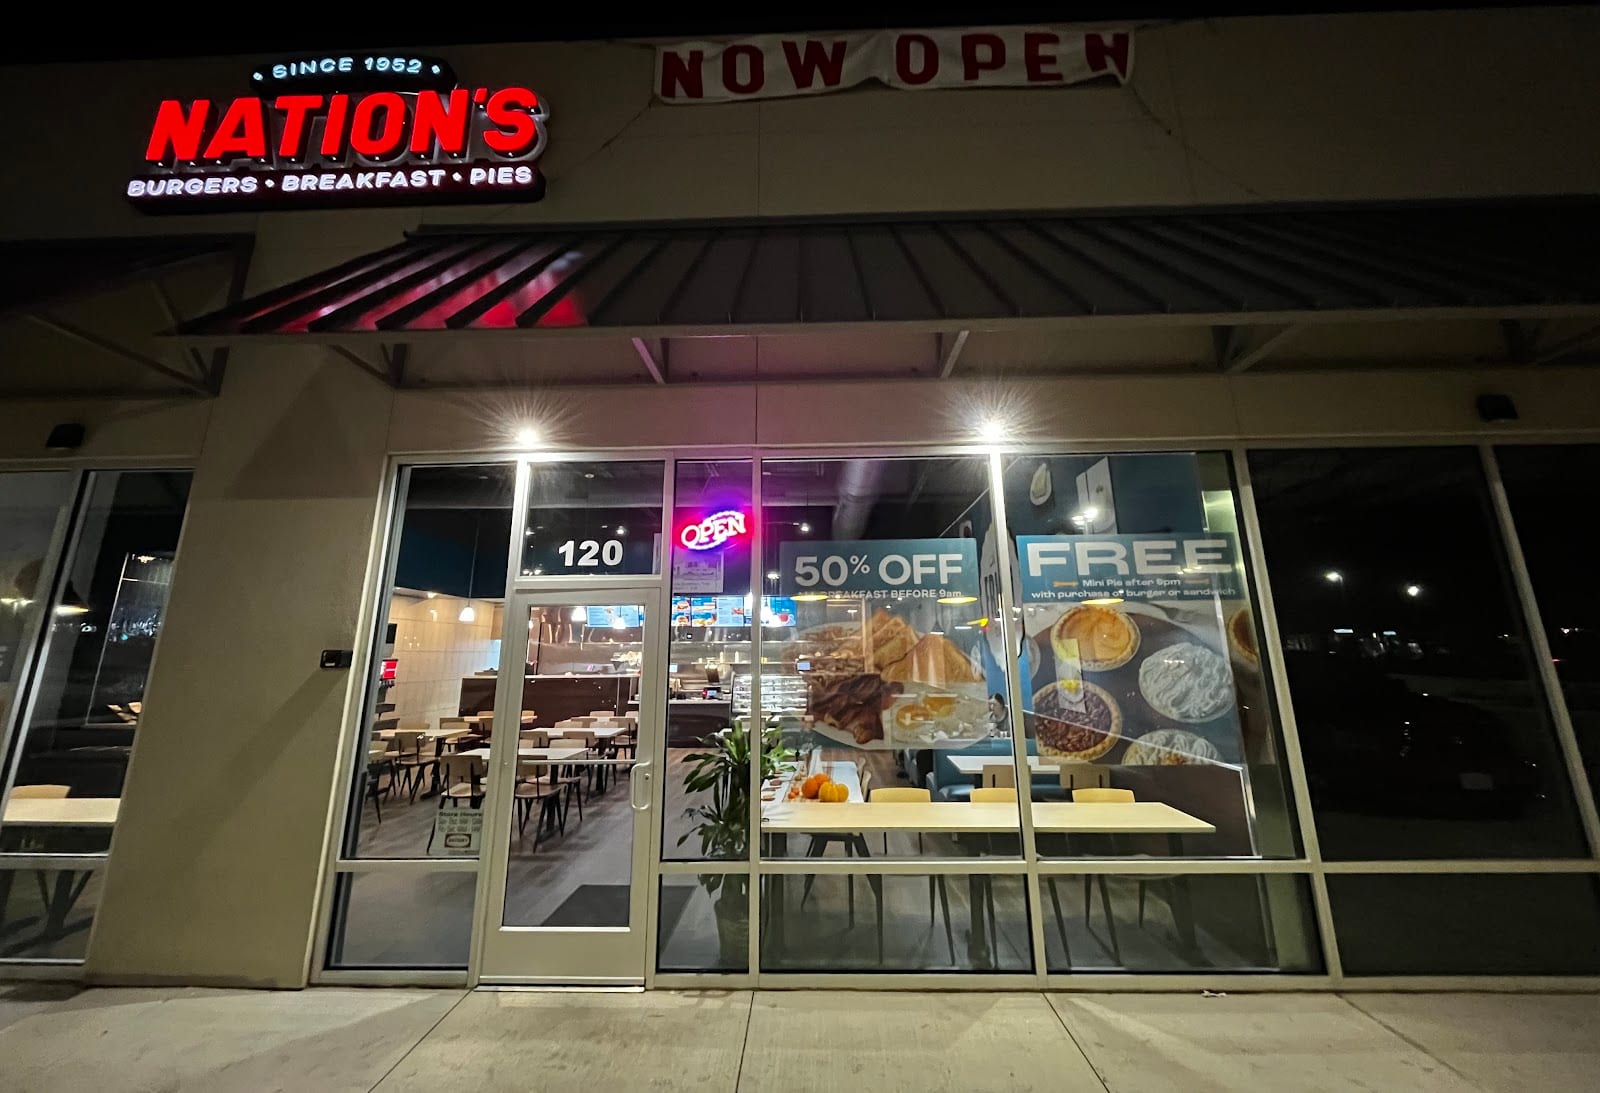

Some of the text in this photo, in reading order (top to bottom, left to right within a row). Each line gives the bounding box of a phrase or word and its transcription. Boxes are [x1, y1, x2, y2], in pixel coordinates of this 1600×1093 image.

[272, 56, 422, 79] SINCE 1952
[660, 32, 1130, 99] NOW OPEN
[145, 87, 539, 161] NATION'S
[127, 166, 533, 196] BURGERS BREAKFAST PIES
[681, 511, 747, 548] OPEN
[558, 539, 624, 567] 120
[1026, 540, 1233, 577] FREE
[794, 553, 963, 587] 50% OFF
[1082, 578, 1104, 587] Mini
[1106, 578, 1123, 587] Pie
[1125, 578, 1154, 587] after
[890, 589, 937, 599] BEFORE
[1032, 589, 1056, 599] with
[1058, 589, 1110, 600] purchase
[1126, 589, 1166, 599] burger
[1168, 589, 1181, 597] or
